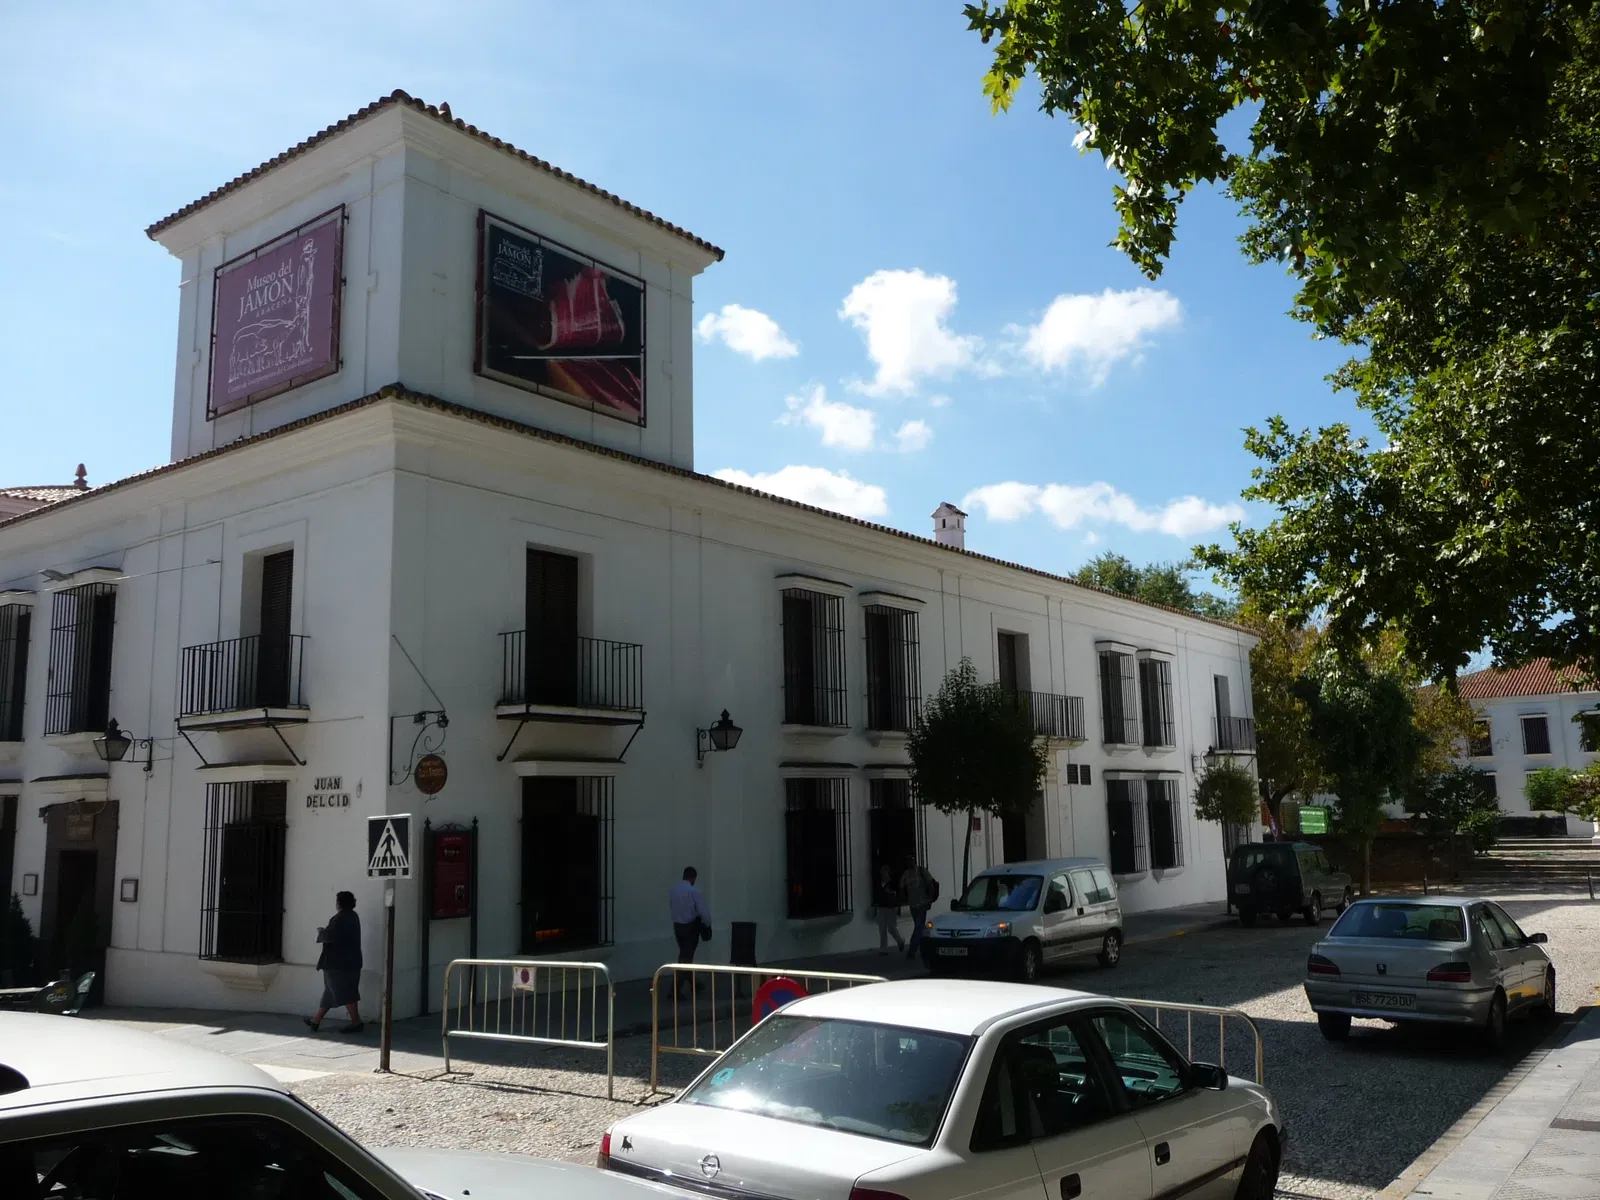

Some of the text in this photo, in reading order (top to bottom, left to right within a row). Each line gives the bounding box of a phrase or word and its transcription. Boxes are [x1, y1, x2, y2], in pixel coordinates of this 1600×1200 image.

[247, 258, 292, 293] Museo del
[314, 777, 341, 790] JUAN
